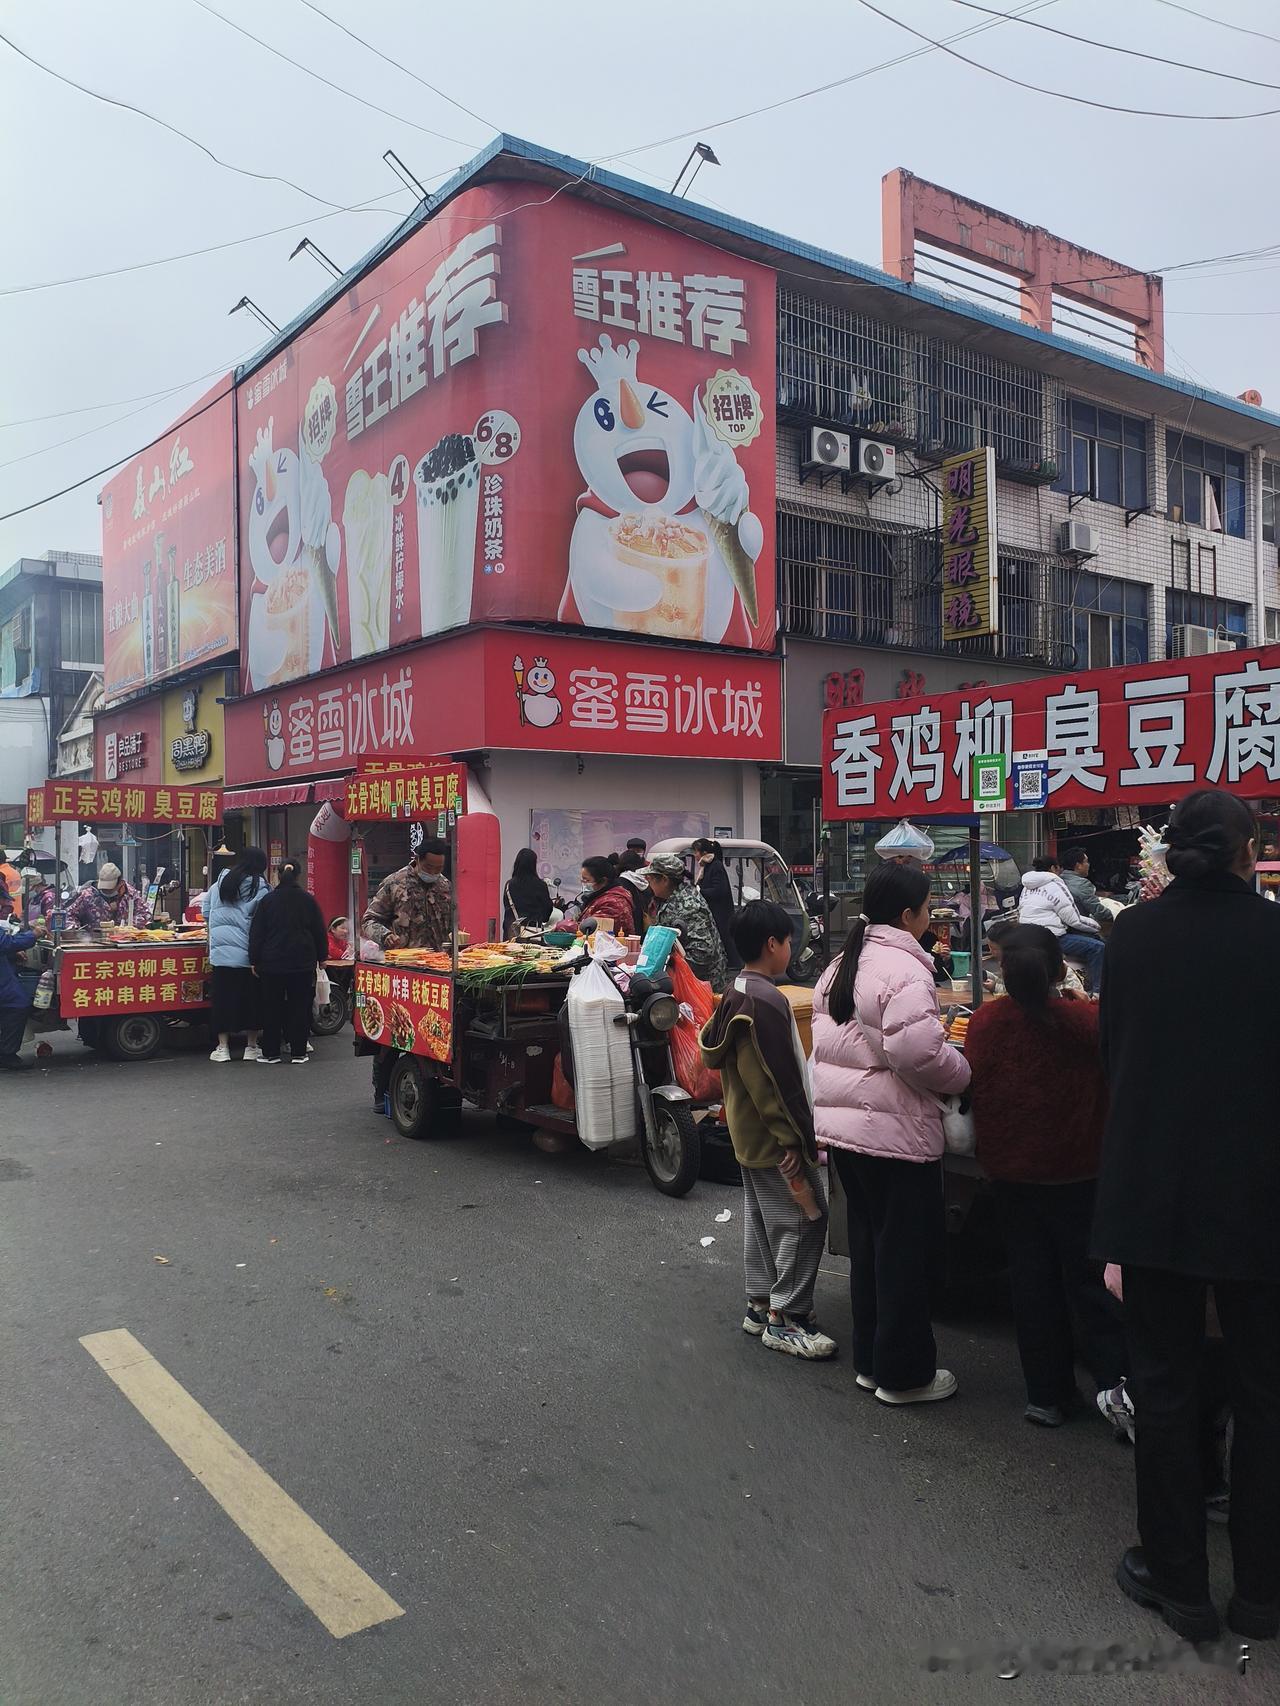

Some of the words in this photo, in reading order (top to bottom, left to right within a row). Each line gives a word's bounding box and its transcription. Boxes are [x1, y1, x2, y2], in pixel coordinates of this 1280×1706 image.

[346, 224, 509, 440] 雪王推荐
[572, 267, 750, 357] 雪王推荐
[308, 396, 332, 443] 招牌
[712, 394, 755, 421] 招牌
[728, 423, 746, 433] TOP
[316, 432, 328, 447] TOP
[484, 473, 503, 560] 珍珠奶茶
[945, 460, 981, 629] 明光眼镜
[288, 667, 414, 765] 蜜雪冰城
[569, 666, 763, 738] 蜜雪冰城
[118, 731, 142, 757] 良品铺子
[172, 731, 208, 759] 周黑鸭
[52, 786, 145, 818] 正宗鸡柳
[153, 789, 218, 820] 臭豆腐
[72, 983, 178, 1008] 各种串串香
[357, 969, 390, 998] 无骨鸡柳
[392, 975, 410, 1001] 炸串
[412, 978, 450, 1011] 铁板豆腐
